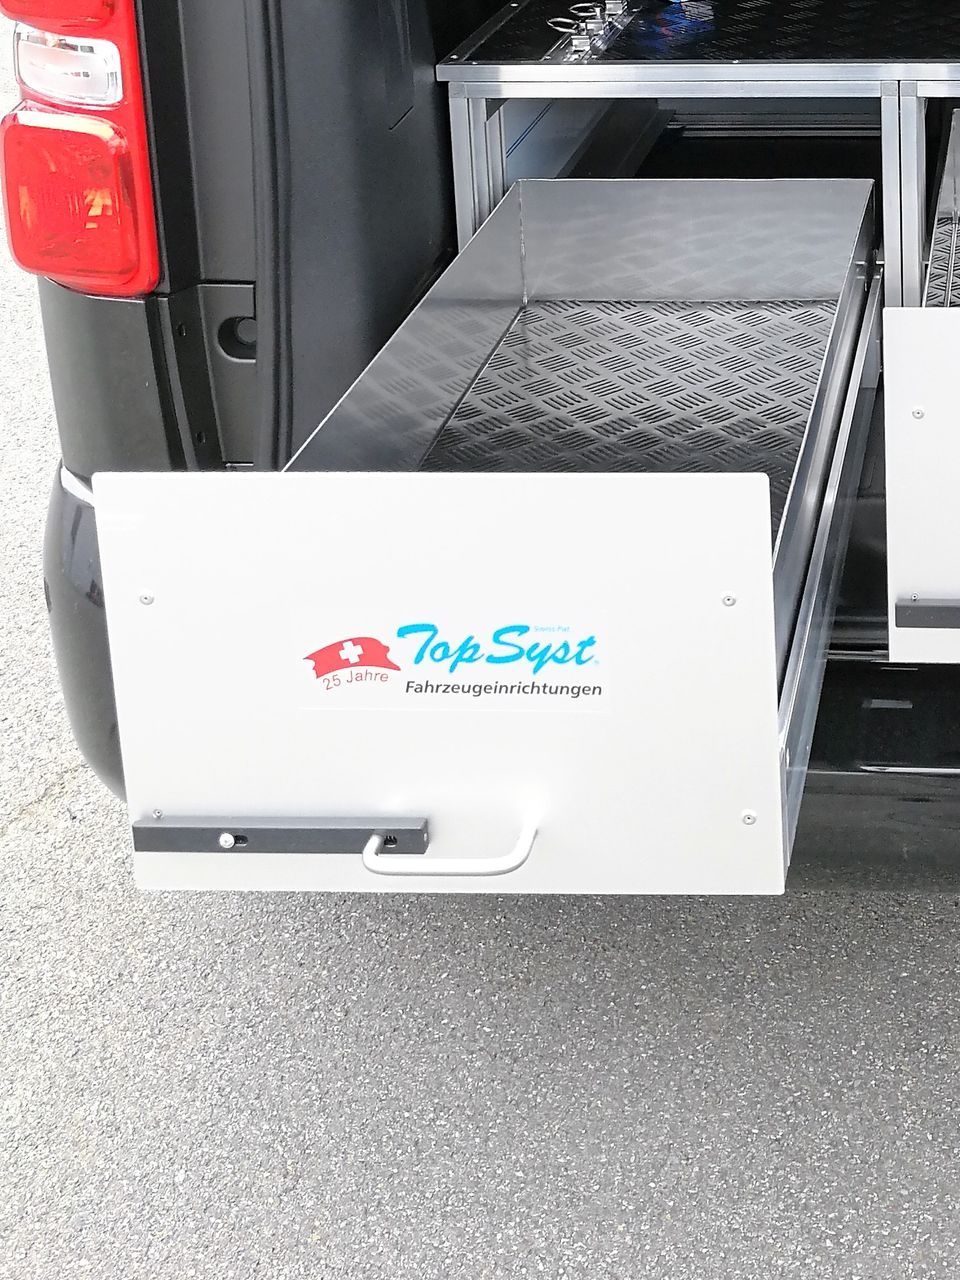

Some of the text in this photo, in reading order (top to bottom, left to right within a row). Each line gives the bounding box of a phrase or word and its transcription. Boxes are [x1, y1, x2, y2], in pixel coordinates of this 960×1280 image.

[322, 668, 389, 691] 25 Jahre
[405, 680, 602, 699] Fahrzeugeinrichtungen
